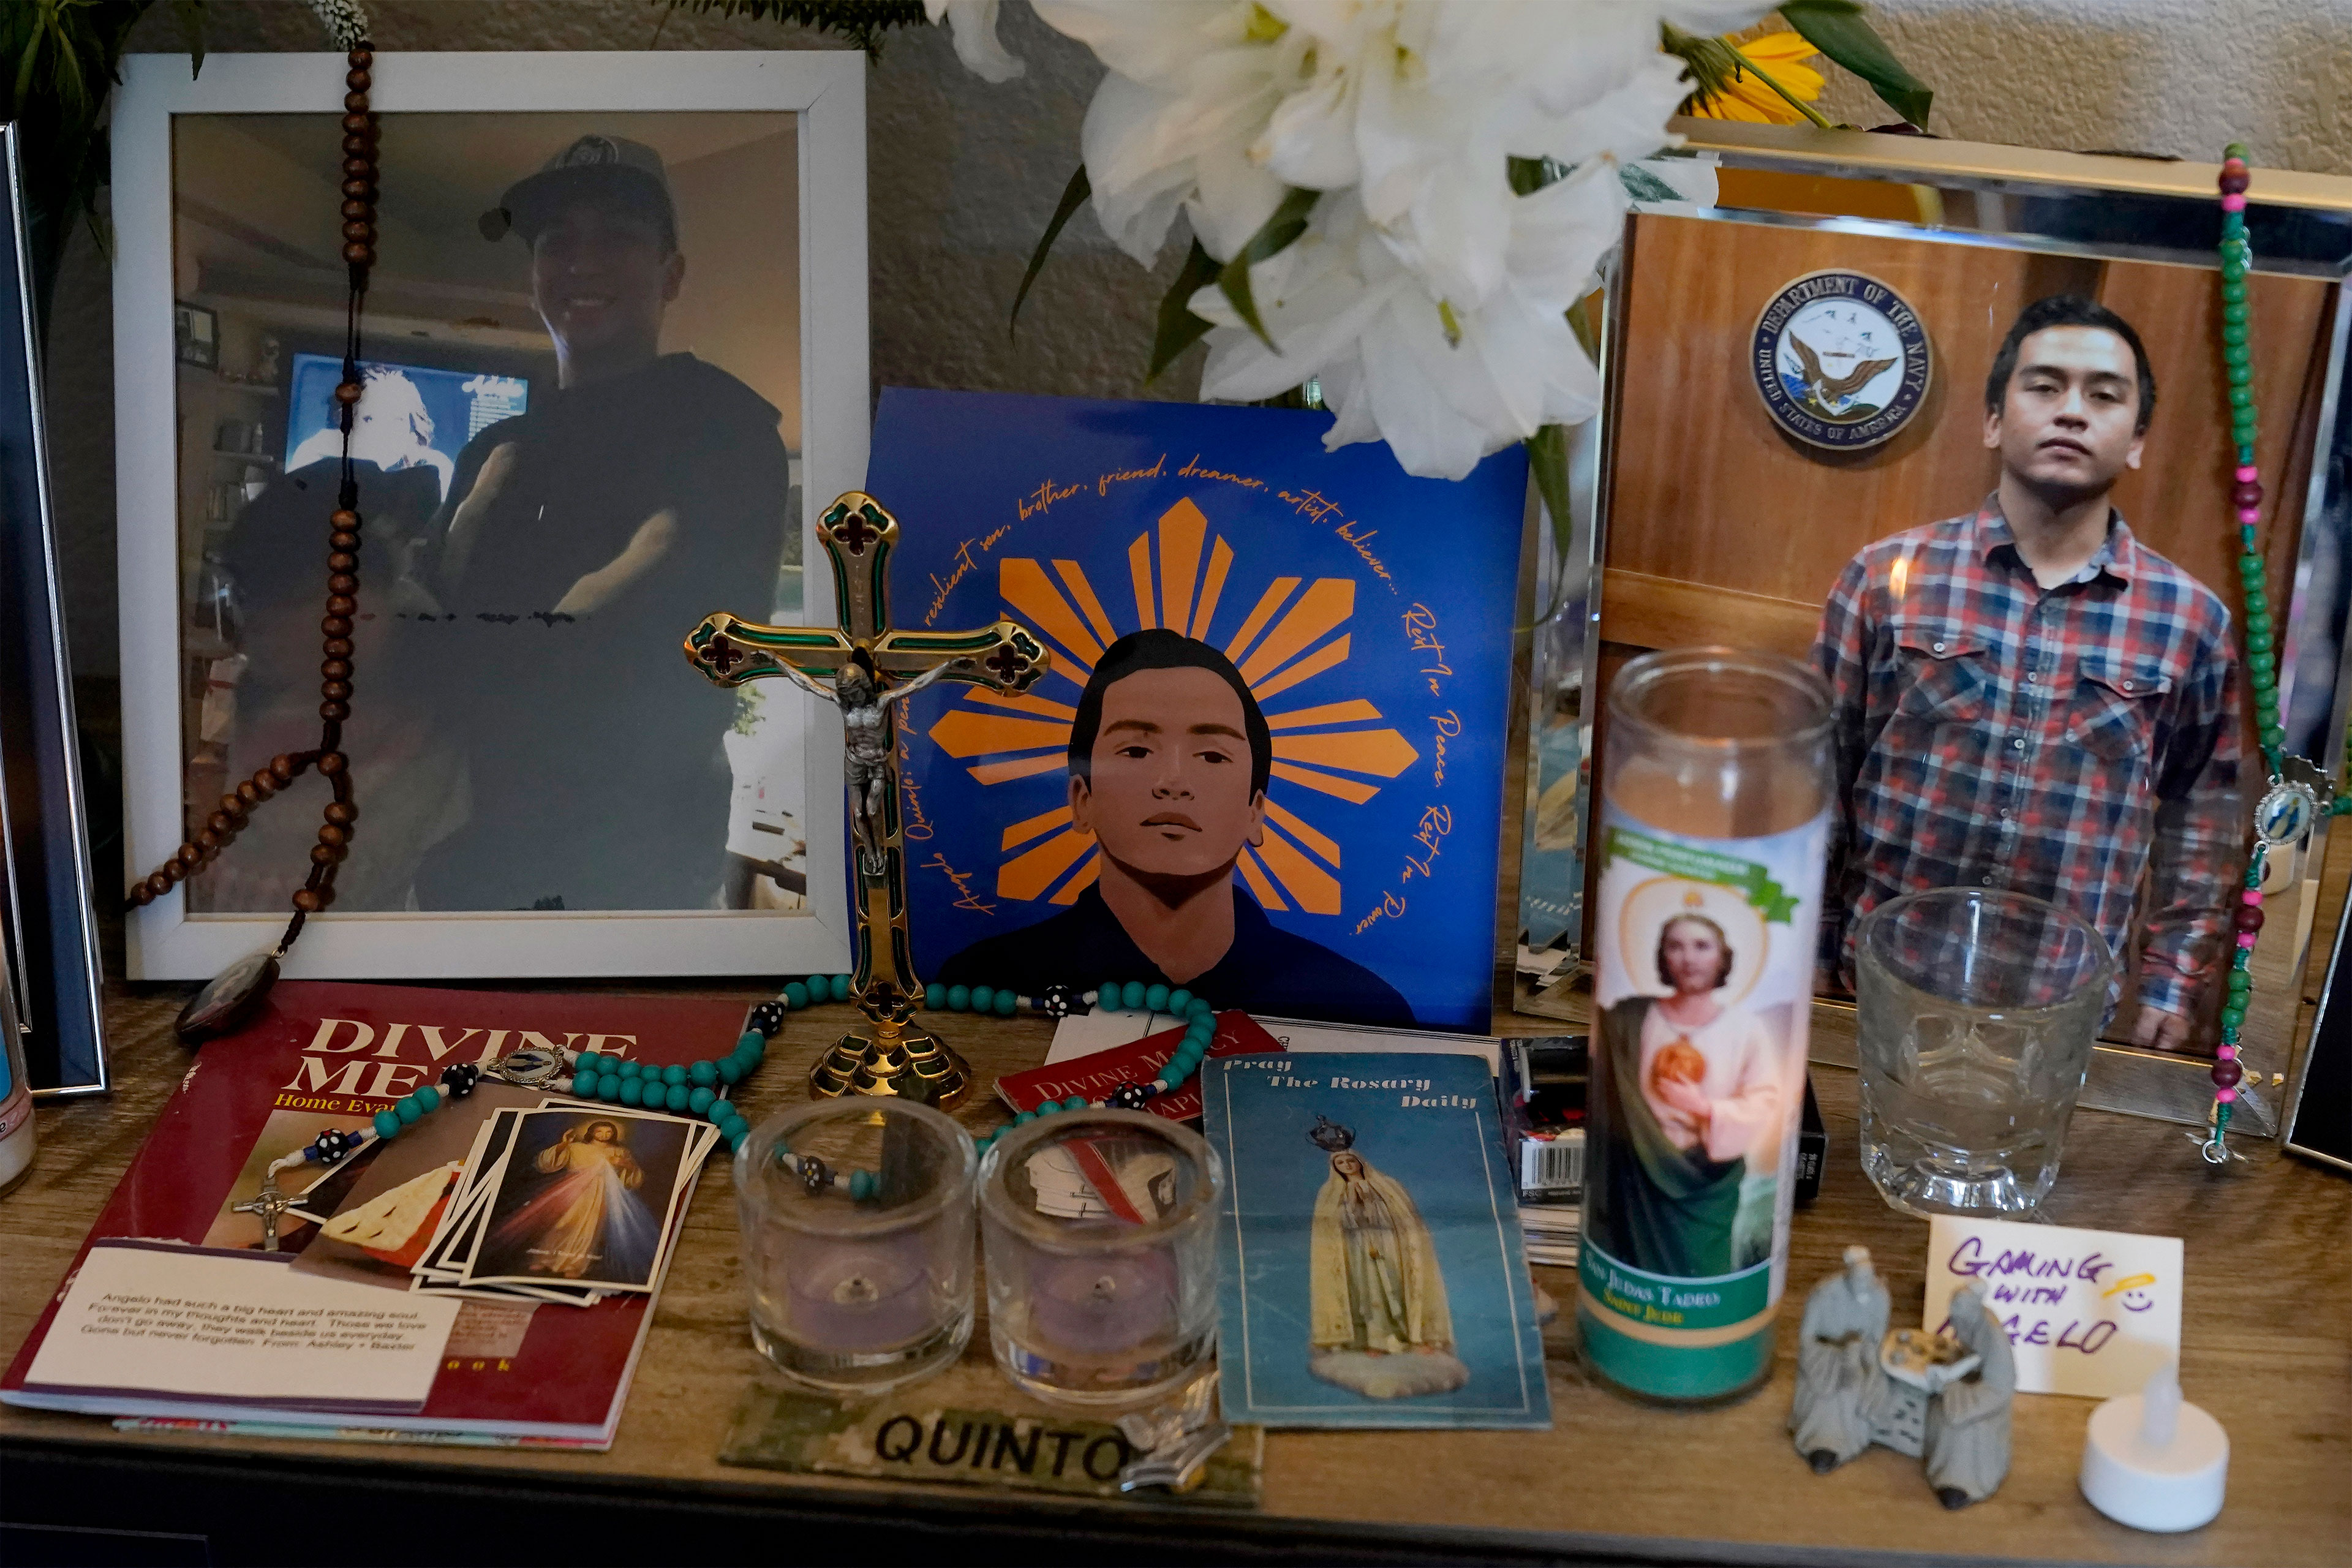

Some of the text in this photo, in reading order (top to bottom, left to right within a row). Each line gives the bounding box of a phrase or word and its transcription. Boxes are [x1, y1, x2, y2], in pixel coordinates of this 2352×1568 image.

[1762, 276, 1926, 392] DEPARTMENT OF THE NAVY
[1758, 349, 1907, 440] UNITED STATES OF AMERICA
[925, 538, 978, 627] resilient
[1401, 603, 1445, 663] Rest
[1420, 663, 1452, 697] In
[904, 771, 935, 840] Quinto:
[1412, 804, 1452, 864] Rest
[1402, 854, 1431, 884] In
[302, 1018, 638, 1064] DIVINE
[1031, 1030, 1241, 1101] DIVINE MCY
[1223, 1060, 1292, 1072] Pray
[1267, 1075, 1431, 1092] The Rosary
[274, 1093, 341, 1111] Home
[1401, 1095, 1477, 1110] Daily
[1948, 1236, 2113, 1283] GAMING
[102, 1293, 151, 1305] Angelo
[153, 1295, 183, 1307] had
[184, 1300, 217, 1310] such
[220, 1303, 231, 1311] a
[233, 1304, 256, 1316] big
[257, 1306, 295, 1317] heart
[296, 1308, 325, 1317] and
[326, 1310, 386, 1319] amazing
[1993, 1284, 2067, 1305] WITH
[134, 1317, 154, 1327] go
[200, 1322, 232, 1334] they
[235, 1325, 266, 1335] walk
[270, 1328, 317, 1338] beside
[144, 1306, 159, 1315] in
[160, 1308, 184, 1319] my
[249, 1317, 277, 1325] and
[329, 1317, 371, 1329] Those
[398, 1321, 428, 1330] love
[1937, 1314, 2117, 1354] GELO
[80, 1324, 119, 1335] Gone
[122, 1326, 148, 1336] but
[149, 1329, 189, 1340] never
[306, 1339, 354, 1351] Ashley
[875, 1414, 1131, 1482] QUINTO
